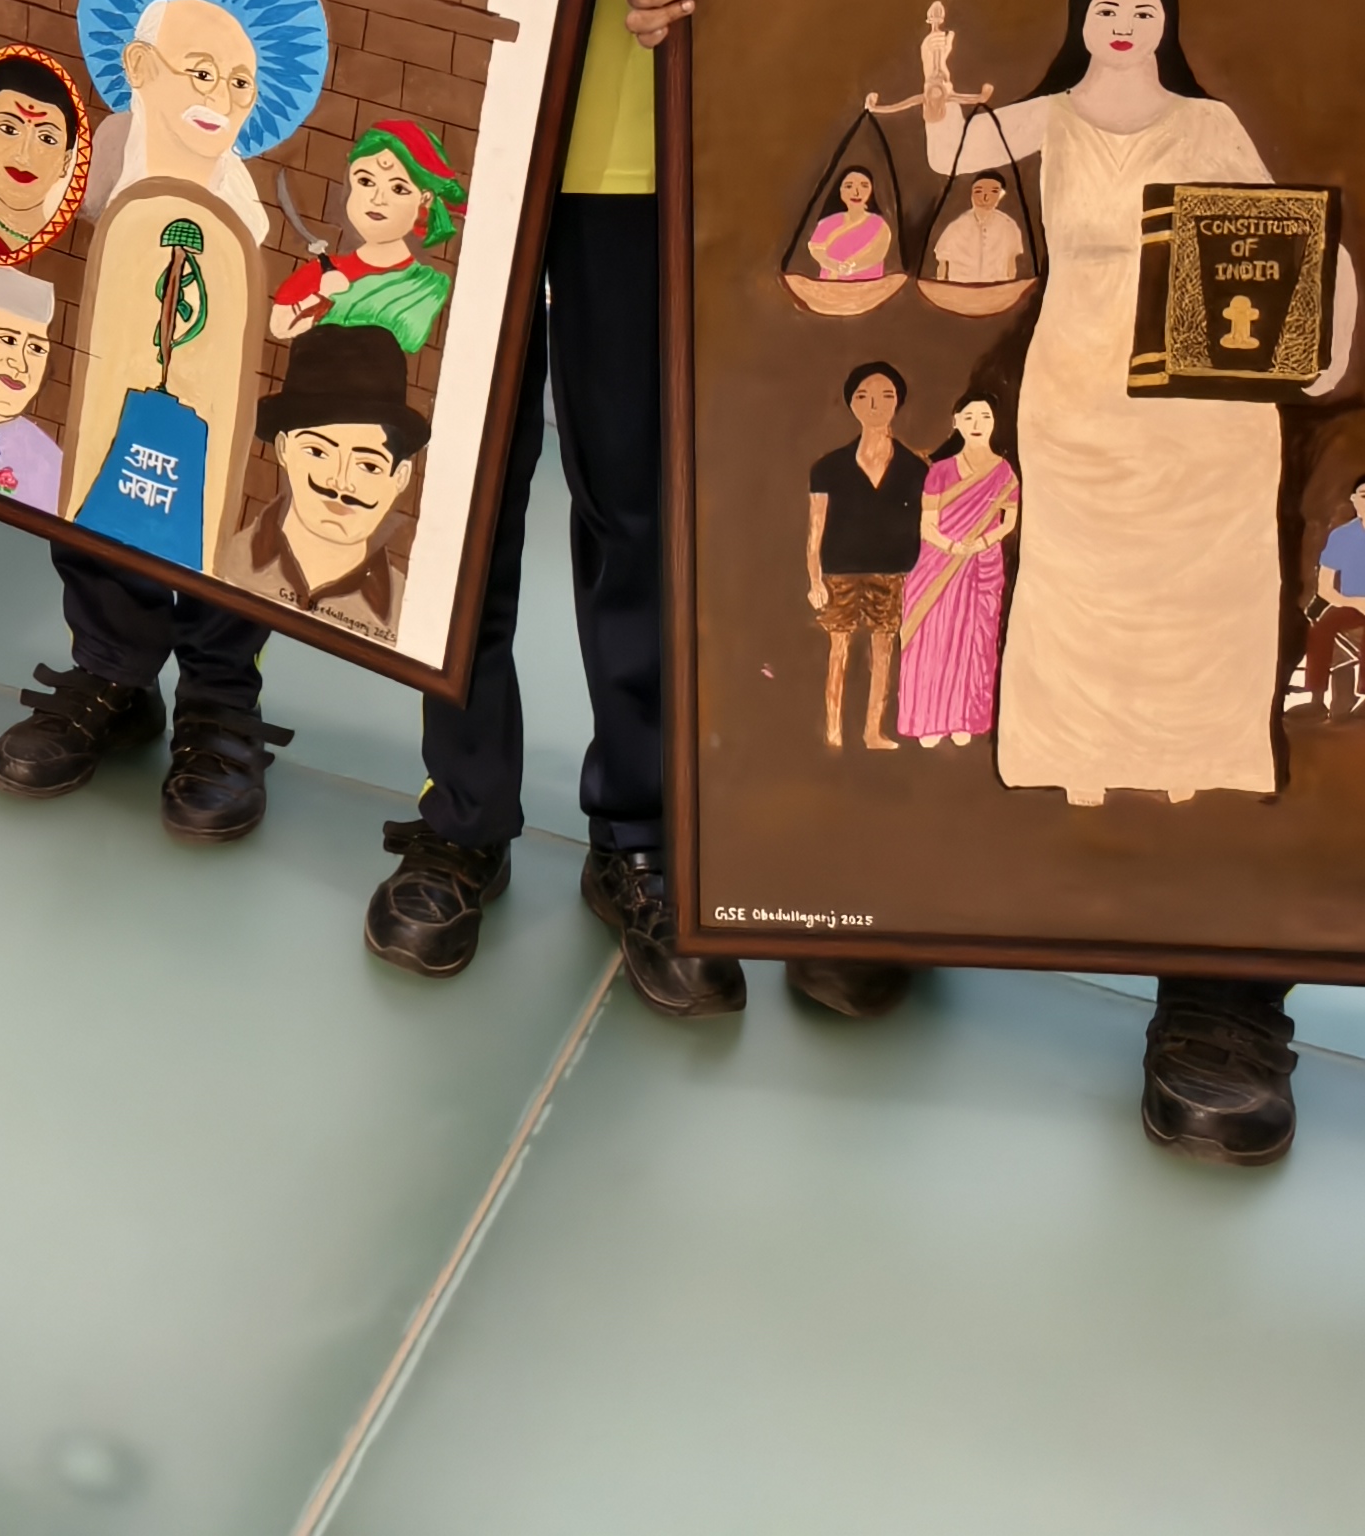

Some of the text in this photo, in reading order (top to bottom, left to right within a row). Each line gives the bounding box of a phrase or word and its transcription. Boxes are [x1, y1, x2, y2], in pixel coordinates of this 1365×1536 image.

[1230, 237, 1260, 257] OF
[1215, 260, 1280, 282] INDIA
[124, 443, 179, 480] अमर
[118, 468, 178, 514] जवान
[714, 906, 746, 921] GSE
[840, 914, 874, 926] 2025
